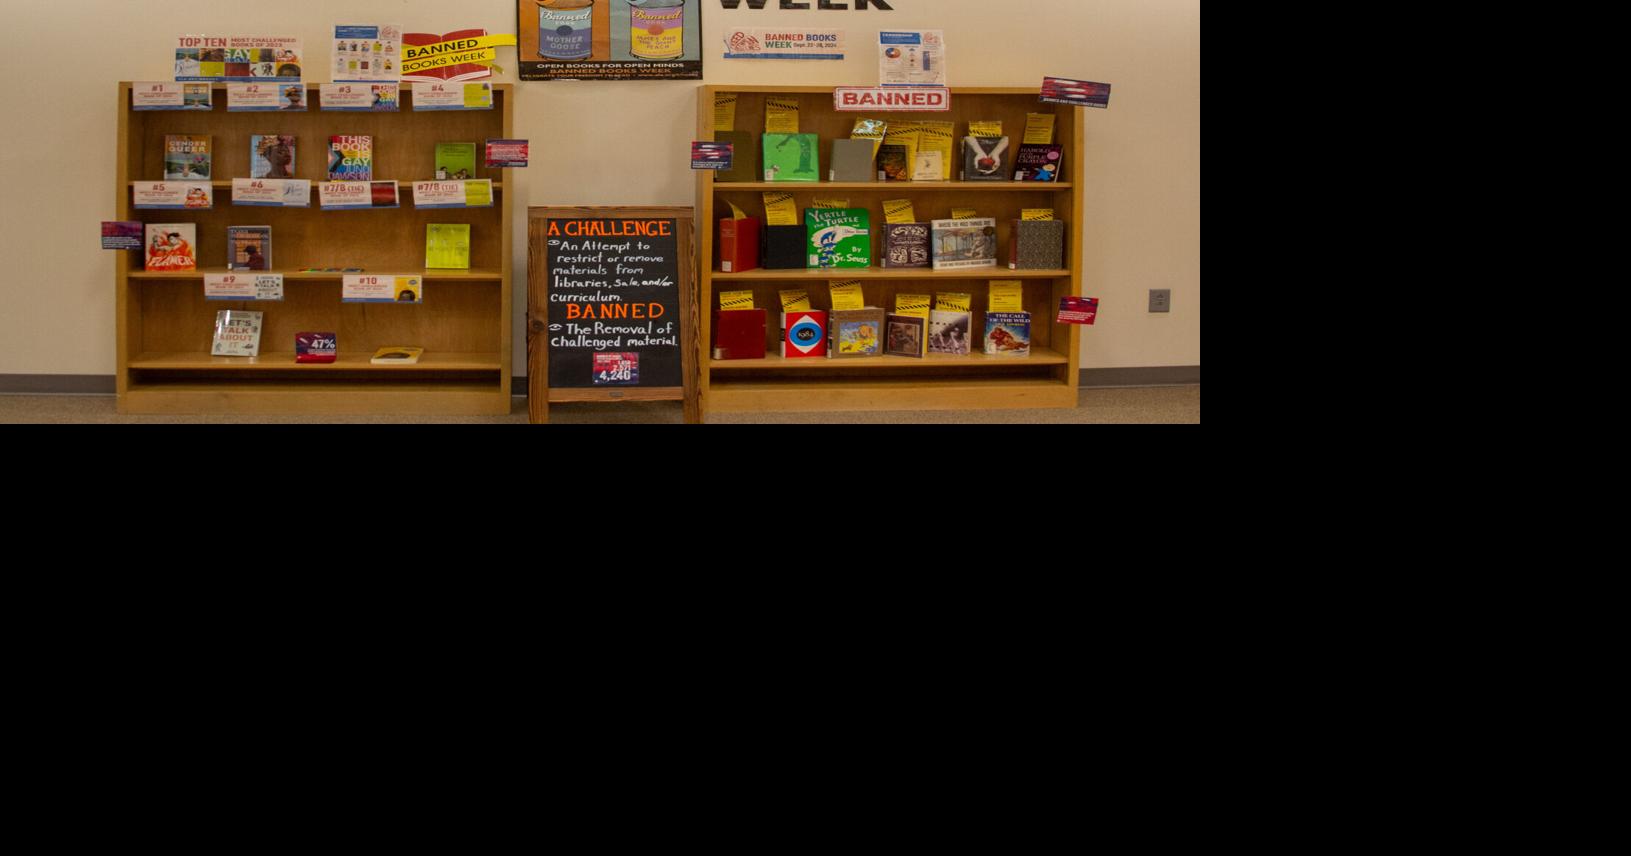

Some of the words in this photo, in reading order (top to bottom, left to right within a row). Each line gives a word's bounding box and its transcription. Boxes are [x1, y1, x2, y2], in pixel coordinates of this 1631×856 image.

[543, 10, 590, 21] Banned
[633, 9, 682, 20] Banned
[178, 37, 201, 47] TOP
[203, 37, 227, 47] TEN
[546, 35, 584, 43] MOTHER
[764, 33, 804, 41] BANNED
[805, 34, 837, 42] BOOKS
[407, 39, 479, 58] BANNED
[402, 57, 447, 72] BOOKS
[450, 51, 487, 63] WEEK
[152, 84, 163, 92] #1
[246, 85, 259, 93] #2
[432, 84, 445, 92] #4
[843, 92, 943, 106] BANNED
[339, 135, 370, 144] THIS
[331, 143, 370, 151] BOOK
[342, 157, 370, 166] GAY
[152, 183, 166, 191] #5
[250, 180, 264, 189] #6
[808, 210, 847, 223] YERTLE
[823, 216, 860, 227] TURTLE
[547, 220, 561, 236] A
[564, 220, 671, 236] CHALLENGE
[560, 240, 578, 251] An
[581, 240, 631, 253] Attempt
[637, 241, 650, 251] to
[146, 255, 195, 267] FLAMER
[556, 252, 603, 263] restrict
[607, 255, 620, 263] or
[623, 255, 664, 263] remove
[846, 253, 868, 263] Seuss
[553, 264, 607, 275] materials
[616, 263, 644, 275] from
[223, 275, 236, 283] #9
[359, 276, 378, 285] #10
[554, 275, 612, 289] libraries,
[641, 275, 674, 287] and/or
[550, 290, 623, 302] curriculum.
[566, 302, 665, 320] BANNED
[566, 323, 592, 335] The
[594, 321, 651, 335] Removal
[656, 322, 673, 334] of
[311, 339, 336, 349] 47%
[600, 370, 631, 382] 4,240
